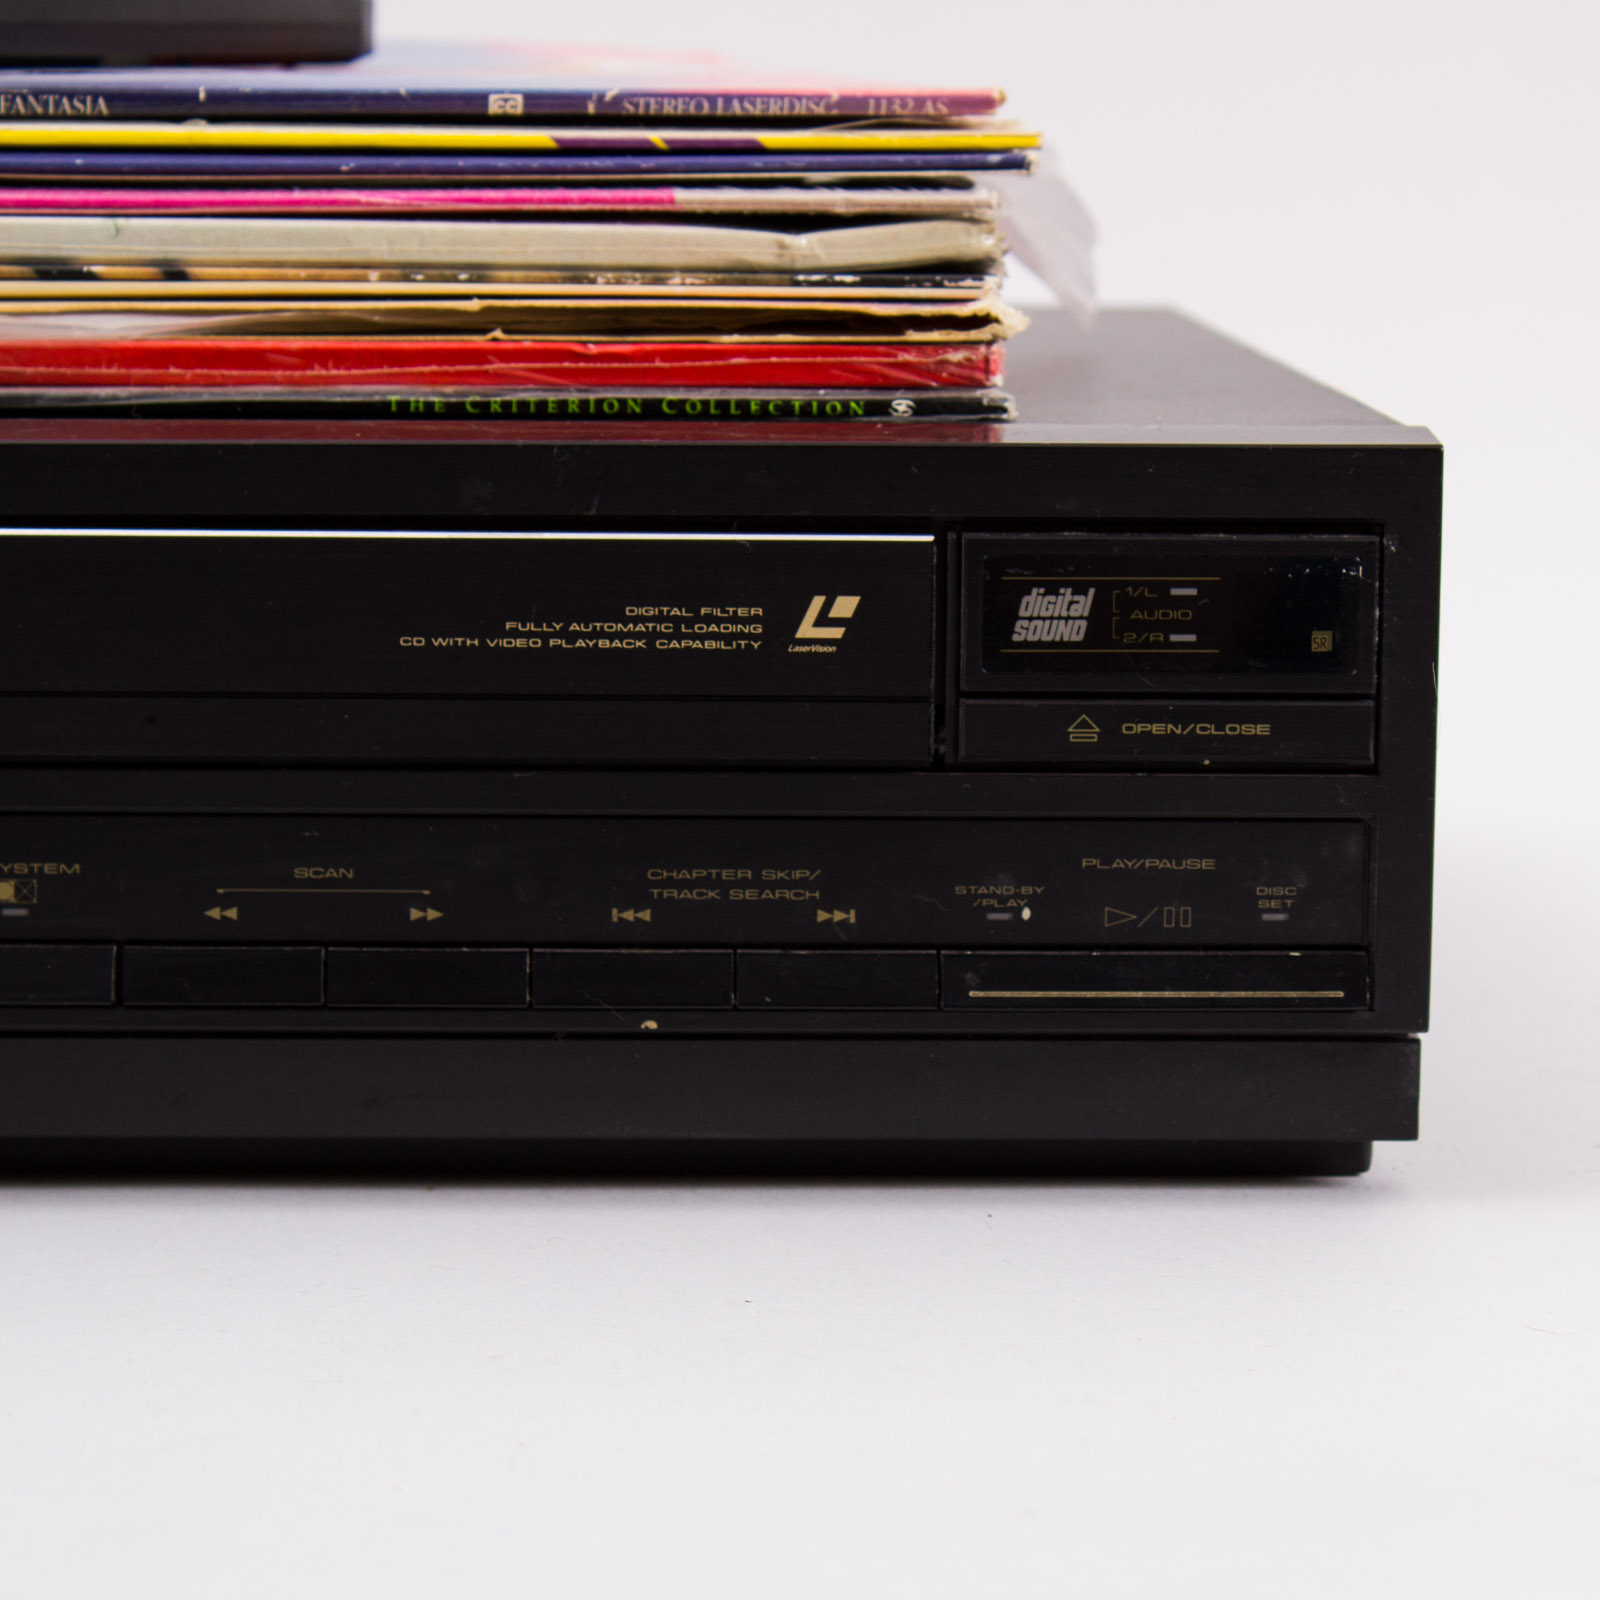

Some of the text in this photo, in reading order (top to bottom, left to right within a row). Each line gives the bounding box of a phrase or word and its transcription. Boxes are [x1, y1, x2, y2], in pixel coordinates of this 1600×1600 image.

[1, 95, 108, 115] FANTASIA
[623, 97, 709, 114] STEREO
[868, 98, 914, 115] 1132
[922, 98, 949, 115] AS
[386, 394, 866, 416] THE CRITERION COLLECTION
[1124, 586, 1159, 598] 1/L
[625, 606, 763, 617] DIGITAL FILTER
[1130, 609, 1193, 621] AUDIO
[505, 621, 763, 634] FULLY AUTOMATIC LOADING
[1012, 619, 1087, 641] SOUND
[399, 636, 762, 651] CD WITH VIDEO PLAYBACK CAPABILITY
[1122, 632, 1165, 644] 2/R
[1311, 635, 1328, 650] SR
[787, 644, 837, 653] LaserVision
[1121, 722, 1271, 736] OPEN/CLOSE
[0, 862, 81, 875] YSTEM
[1081, 857, 1216, 870] PLAY/PAUSE
[293, 867, 354, 879] SCAN
[647, 868, 822, 881] CHAPTER SKIP/
[648, 888, 820, 901] TRACK SEARCH
[954, 885, 1045, 895] STAND-BY
[1255, 886, 1297, 896] DISC
[972, 898, 1028, 909] /PLAY
[1258, 899, 1295, 909] SET
